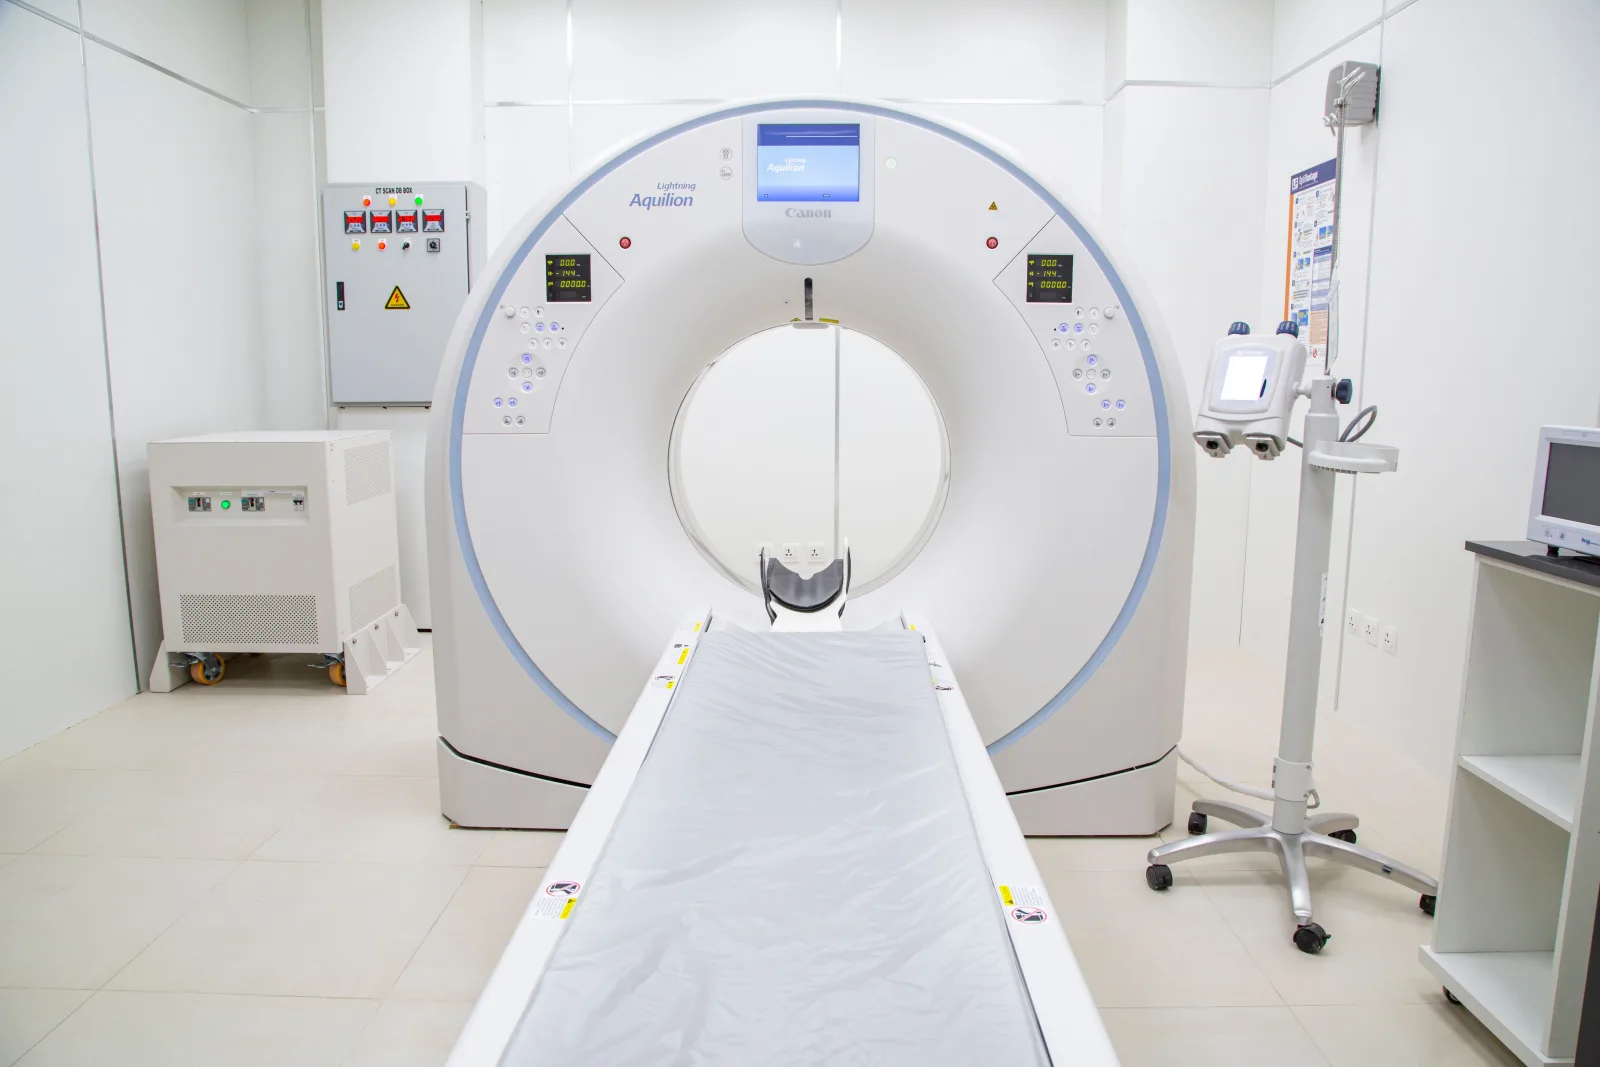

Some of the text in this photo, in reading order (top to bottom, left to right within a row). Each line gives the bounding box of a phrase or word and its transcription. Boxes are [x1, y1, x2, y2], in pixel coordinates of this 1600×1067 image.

[766, 162, 805, 173] Aquilion
[657, 181, 696, 191] Lightning
[629, 192, 694, 211] Aquilion
[784, 207, 832, 219] Canon
